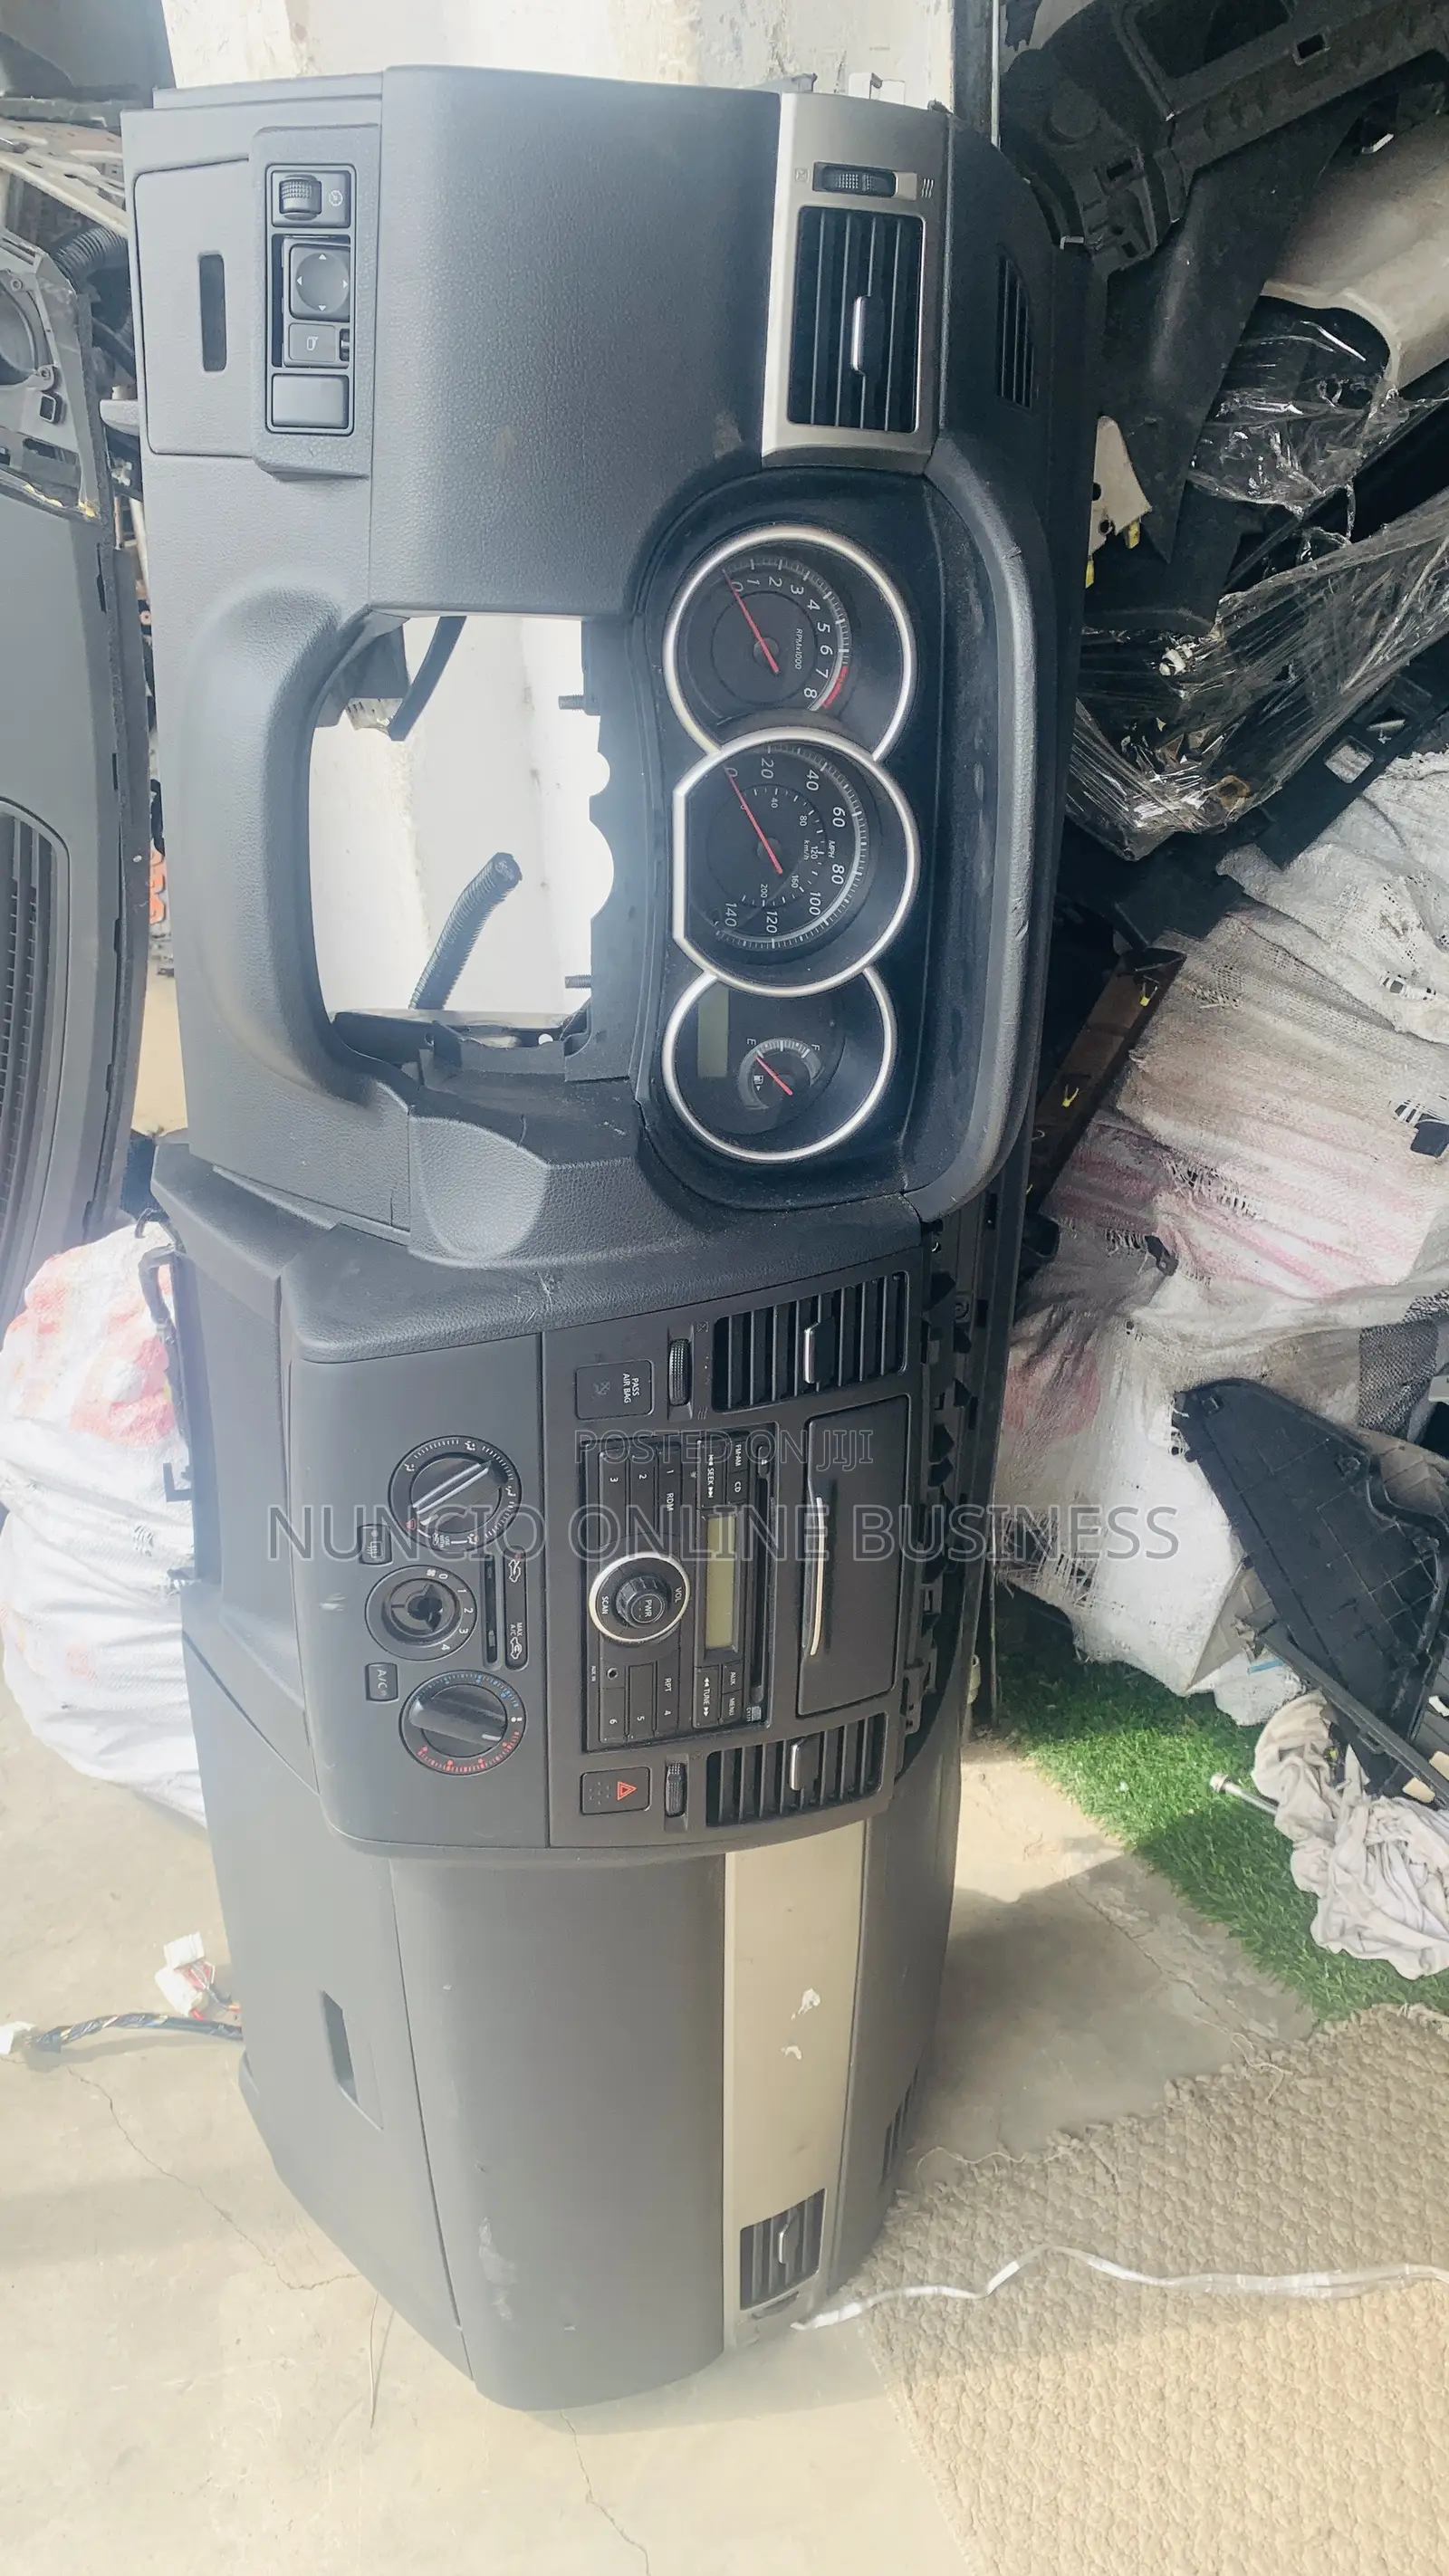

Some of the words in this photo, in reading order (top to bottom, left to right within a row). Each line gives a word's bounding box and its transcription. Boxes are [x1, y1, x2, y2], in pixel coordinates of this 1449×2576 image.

[769, 576, 782, 588] 2
[791, 584, 804, 597] 3
[807, 599, 820, 611] 4
[817, 621, 830, 634] 5
[820, 645, 833, 656] 6
[816, 668, 829, 679] 7
[804, 687, 818, 699] 8
[761, 757, 774, 780] 20
[806, 770, 820, 791] 40
[771, 798, 779, 809] 40
[799, 815, 808, 827] 80
[832, 806, 846, 828] 60
[811, 846, 819, 860] 120
[828, 840, 836, 859] MPH
[791, 874, 799, 888] 160
[830, 863, 845, 886] 80
[761, 884, 769, 898] 200
[809, 891, 822, 916] 100
[724, 902, 737, 927] 140
[766, 911, 778, 934] 120
[746, 1038, 757, 1046] E
[811, 1043, 820, 1051] F
[622, 1373, 630, 1386] AIR
[632, 1377, 640, 1397] PASS
[623, 1388, 631, 1404] BAG
[734, 1481, 742, 1493] CD
[666, 1492, 674, 1512] RDM
[675, 1586, 683, 1604] VOL
[600, 1595, 609, 1614] SCAN
[644, 1599, 653, 1618] PWR
[377, 1669, 388, 1690] A/C
[664, 1677, 672, 1692] RPT
[703, 1688, 711, 1706] TUNE
